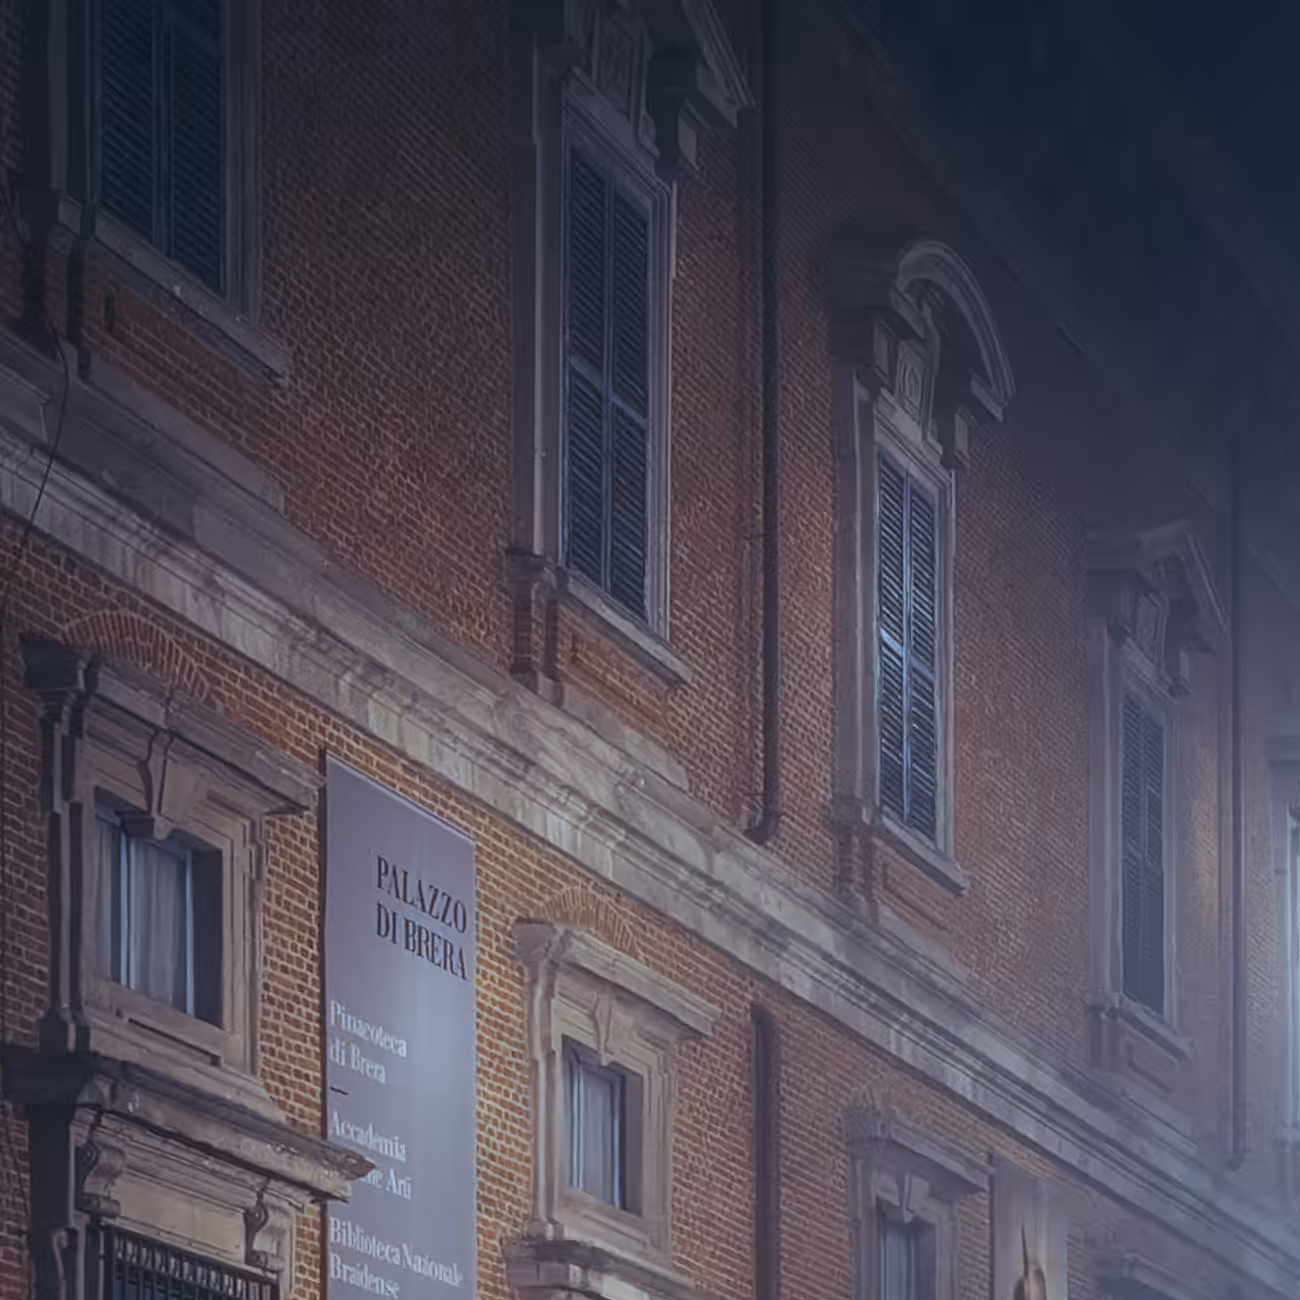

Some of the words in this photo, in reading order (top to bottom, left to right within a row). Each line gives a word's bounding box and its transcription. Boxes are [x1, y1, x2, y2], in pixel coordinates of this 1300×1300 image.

[377, 855, 467, 933] PALAZZO
[377, 902, 397, 944] DI
[404, 917, 467, 980] BRERA
[330, 1000, 408, 1058] Pinacoteca
[330, 1039, 346, 1066] di
[350, 1043, 386, 1084] Brera
[330, 1110, 406, 1162] Accademia
[386, 1168, 411, 1200] Arti
[330, 1217, 401, 1266] Biblioteca
[402, 1243, 463, 1287] Nazionale
[330, 1252, 400, 1299] Braidense
